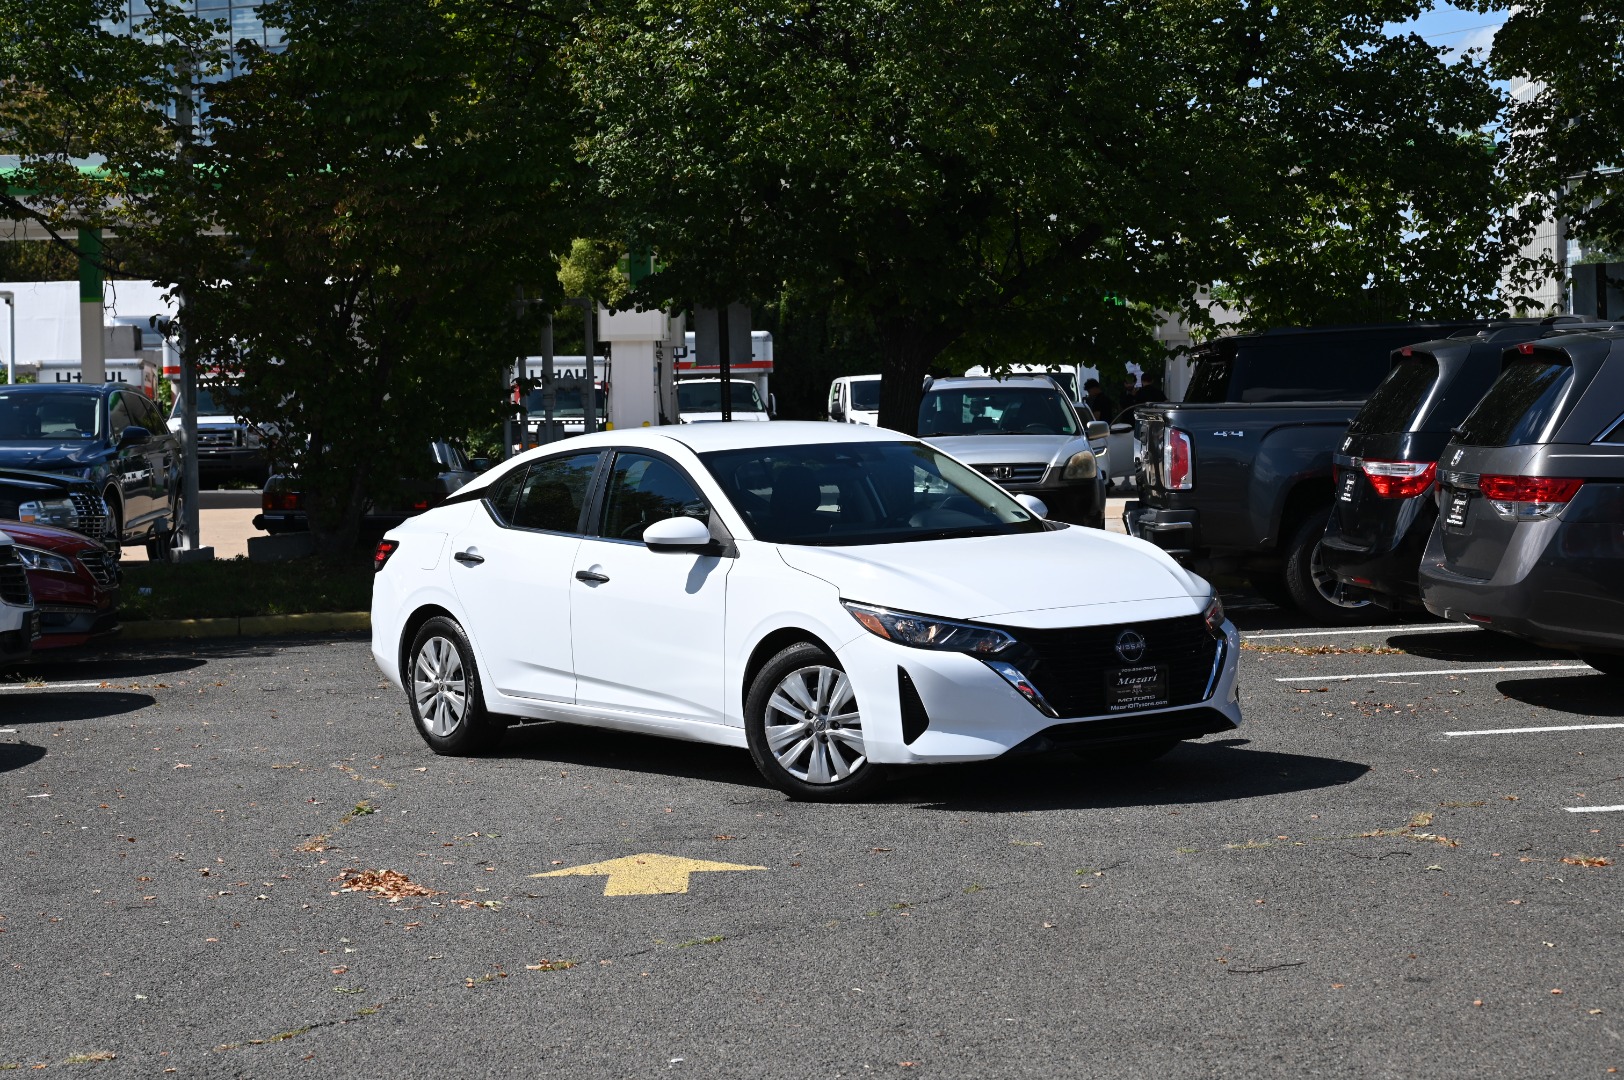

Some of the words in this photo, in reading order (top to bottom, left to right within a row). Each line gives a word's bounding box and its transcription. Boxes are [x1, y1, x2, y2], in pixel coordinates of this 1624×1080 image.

[1115, 642, 1146, 651] NISSAN
[1116, 673, 1158, 686] Mazari
[1117, 694, 1156, 703] MOTORS
